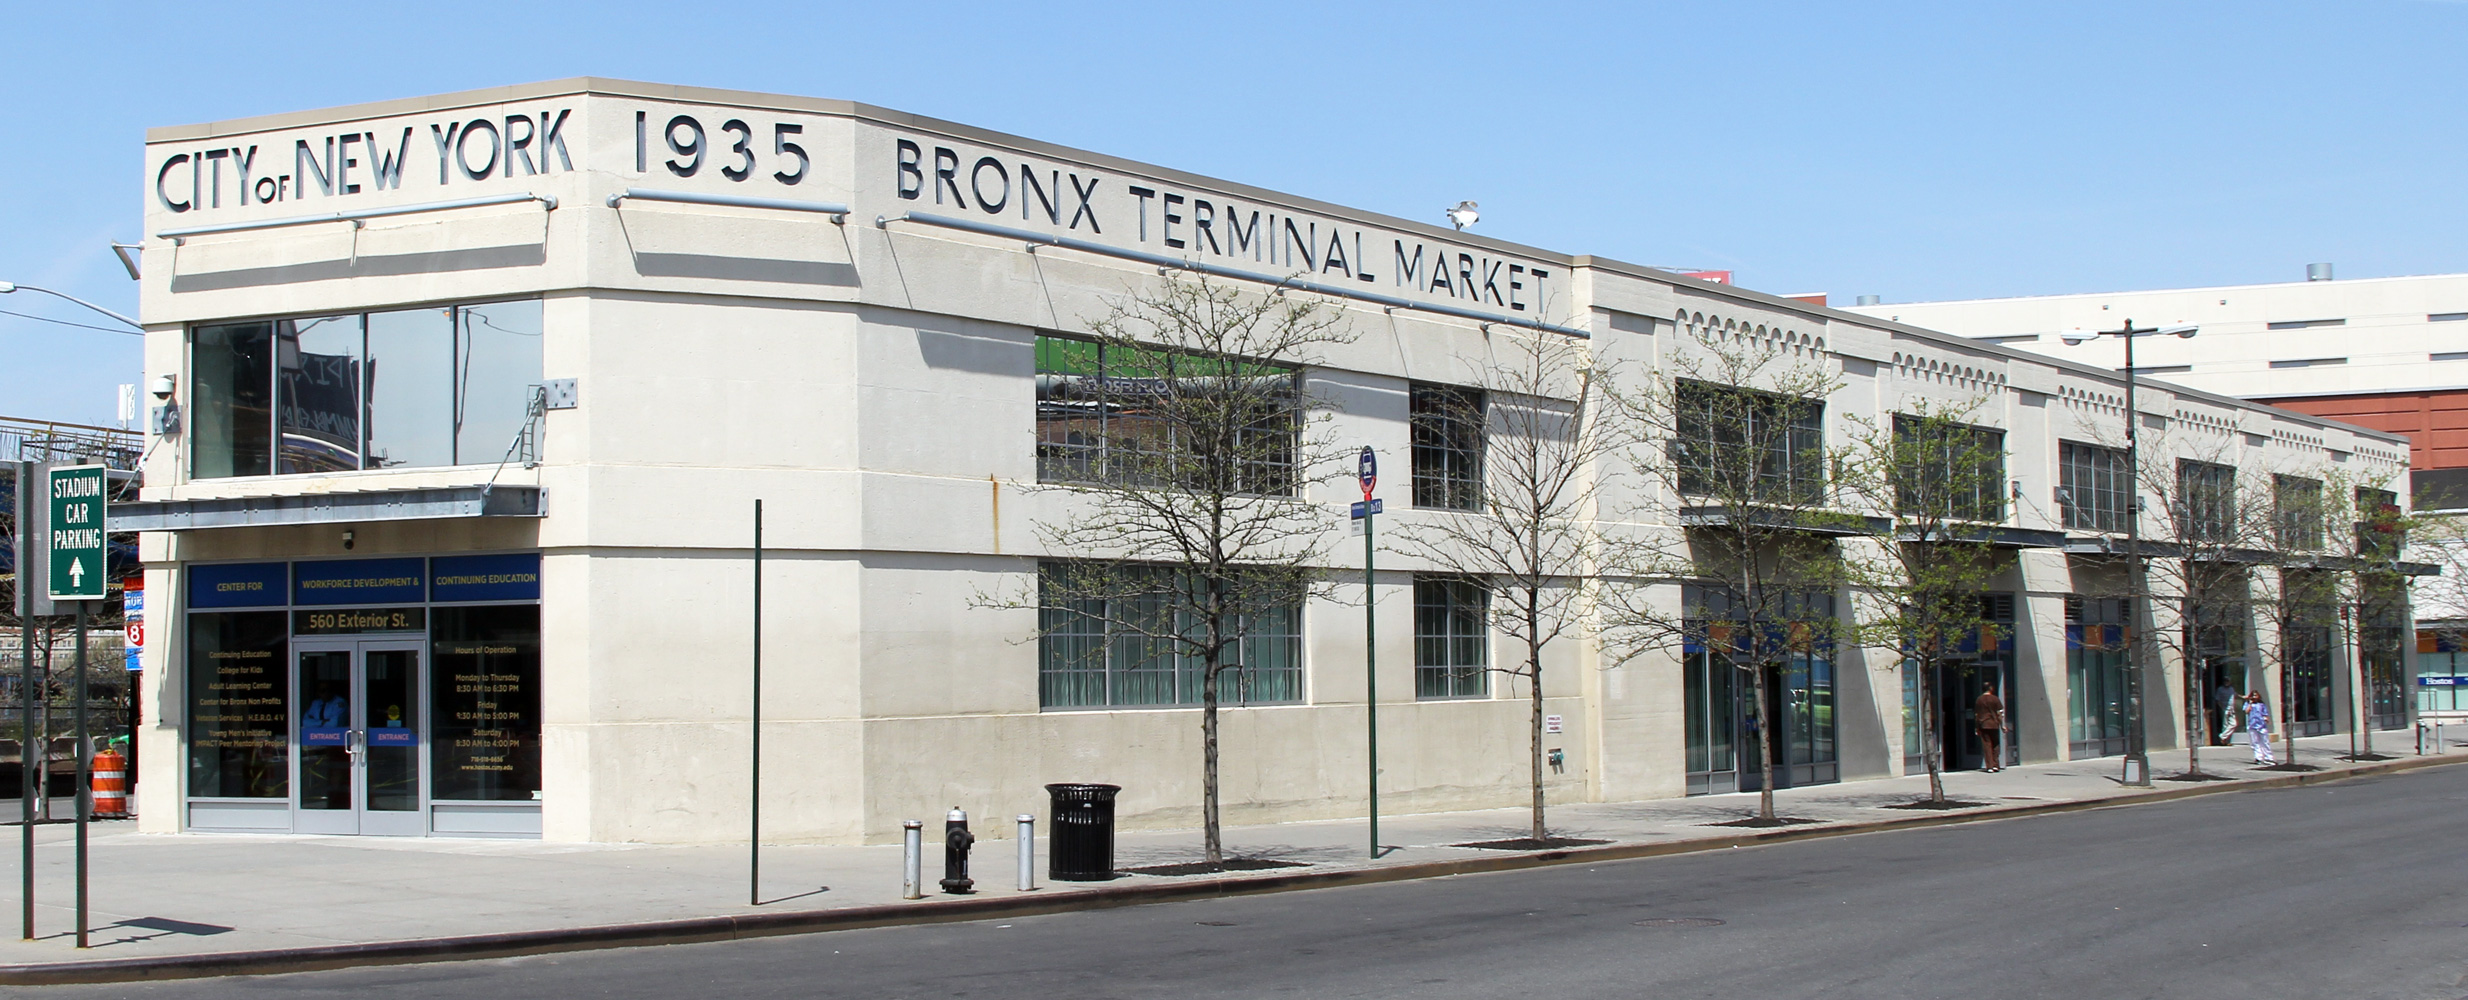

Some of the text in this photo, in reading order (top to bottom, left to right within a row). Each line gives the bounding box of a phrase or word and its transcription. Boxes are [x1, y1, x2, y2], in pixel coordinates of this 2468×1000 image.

[636, 111, 810, 185] 1935
[157, 109, 574, 213] CITY OF NEW YORK
[897, 138, 1549, 314] BRONX TERMINAL MARKET
[54, 476, 100, 499] STADIUM
[65, 503, 89, 524] CAR
[54, 528, 101, 550] PARKING
[302, 577, 419, 589] WORKFORCE DEVELOPMENT &
[436, 573, 536, 586] CONTINUING EDUCATION
[217, 581, 263, 592] CENTER FOR
[310, 613, 409, 628] 560 Exterior St.
[209, 650, 272, 659] Continuing Education
[475, 646, 483, 654] of
[484, 646, 517, 655] Operation
[216, 666, 263, 675] College for Kids
[455, 674, 480, 682] Monday
[490, 673, 520, 682] Thursday
[225, 683, 251, 691] Learning
[252, 682, 272, 690] Center
[472, 684, 483, 692] AM
[508, 684, 519, 692] PM
[200, 698, 219, 706] Center
[477, 701, 498, 710] Friday
[472, 712, 483, 720] AM
[484, 712, 491, 720] to
[492, 712, 508, 720] 5:00
[378, 733, 410, 741] ENTRANCE
[473, 728, 502, 738] Saturday
[456, 740, 520, 748] 8:30 AM to 4:00 PM
